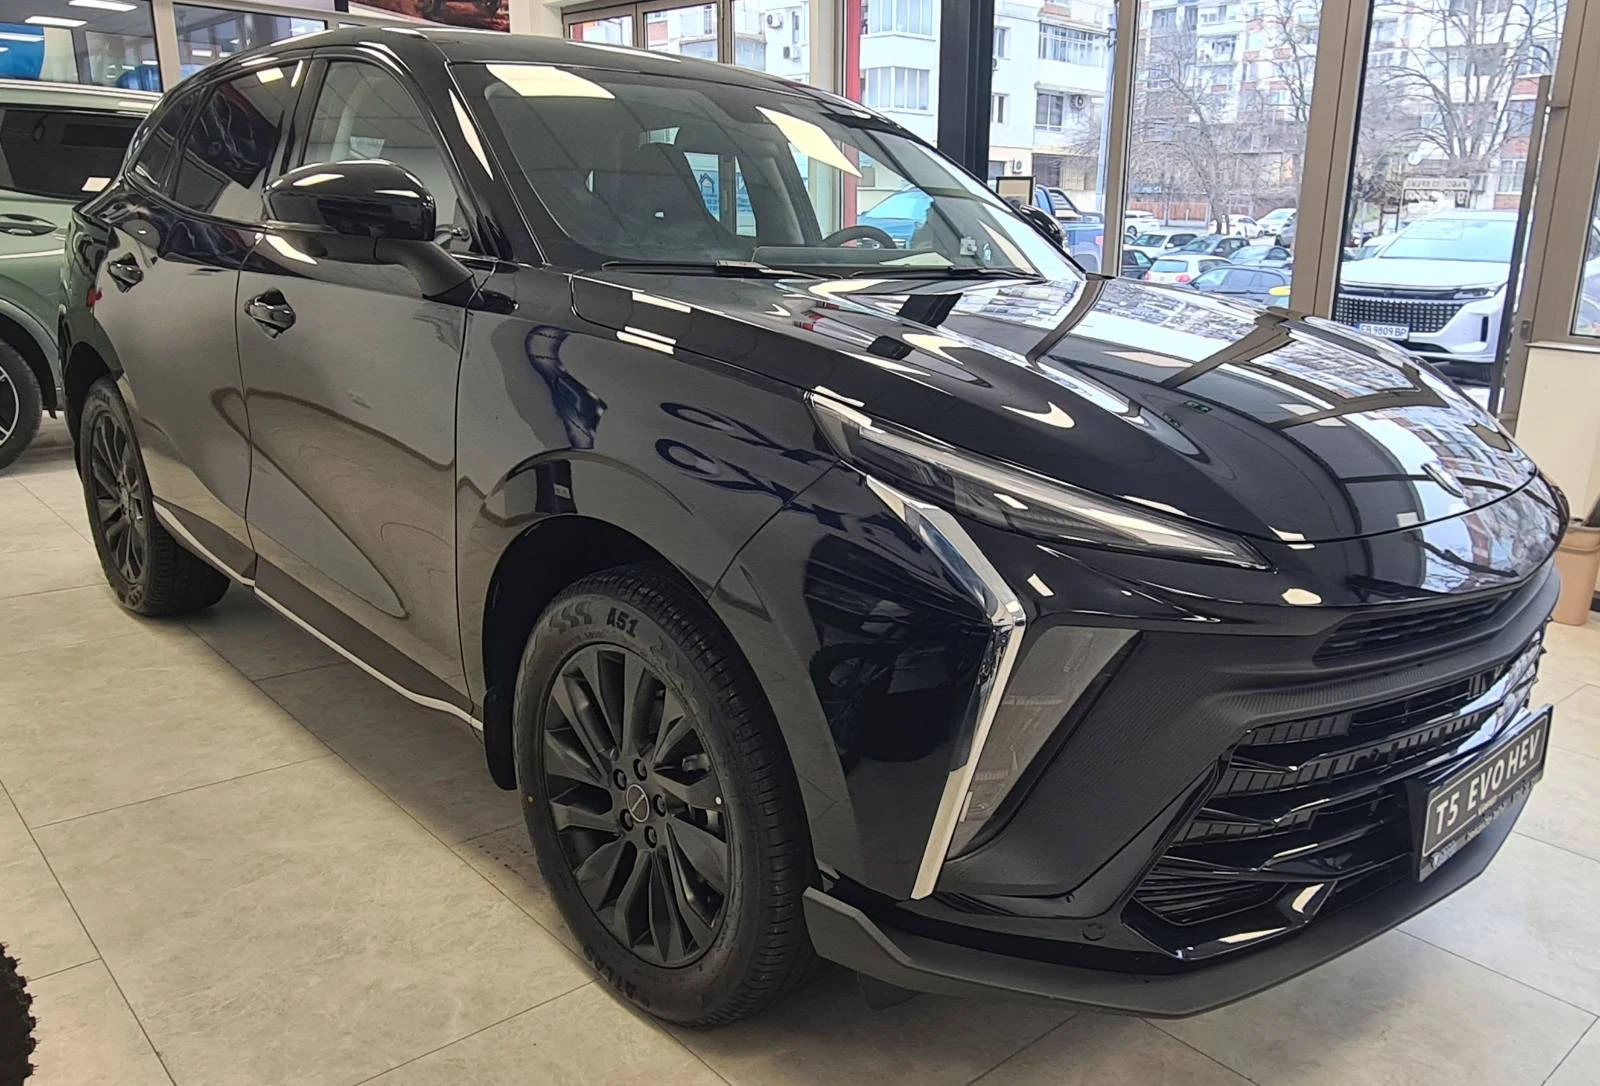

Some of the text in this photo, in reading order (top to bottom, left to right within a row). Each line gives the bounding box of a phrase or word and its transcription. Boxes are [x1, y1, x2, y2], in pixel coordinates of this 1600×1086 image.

[606, 607, 639, 638] A51
[1436, 791, 1460, 835] T5
[1467, 759, 1505, 811] EVO
[1506, 729, 1540, 779] HEV
